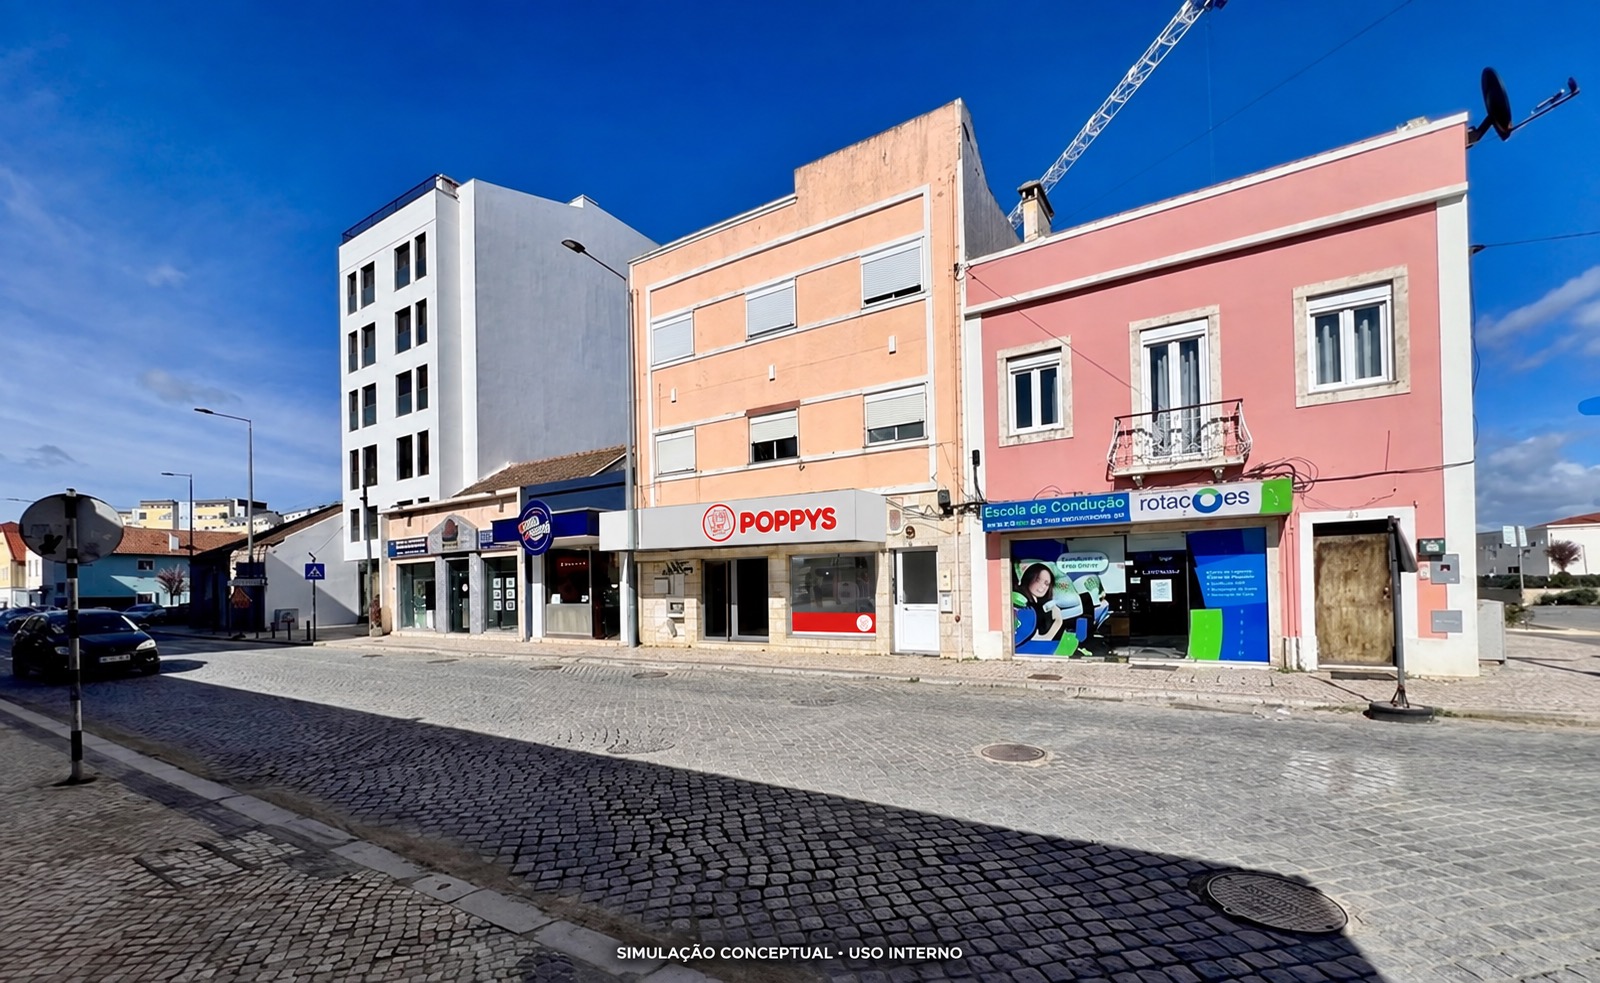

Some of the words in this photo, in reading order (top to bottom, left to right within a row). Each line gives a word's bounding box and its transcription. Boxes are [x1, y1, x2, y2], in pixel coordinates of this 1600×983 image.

[985, 505, 1026, 518] Escola
[1030, 503, 1047, 514] de
[1051, 496, 1125, 512] Condução
[740, 506, 837, 533] POPPYS
[905, 525, 916, 539] 9
